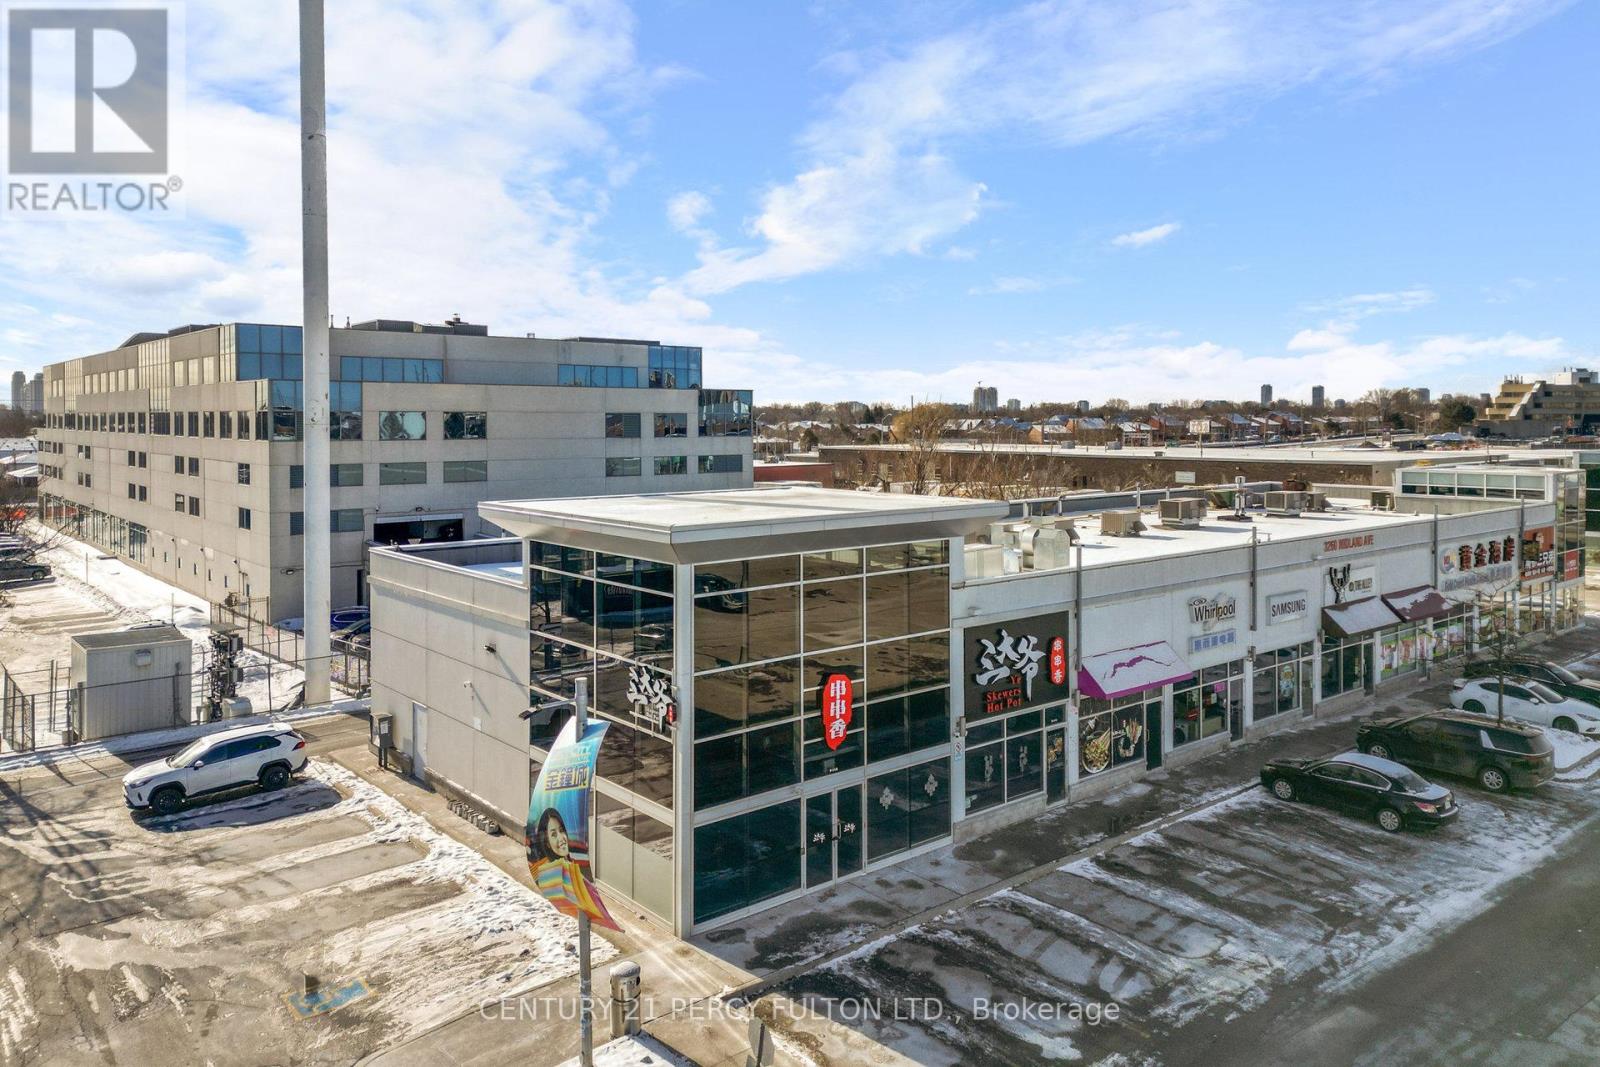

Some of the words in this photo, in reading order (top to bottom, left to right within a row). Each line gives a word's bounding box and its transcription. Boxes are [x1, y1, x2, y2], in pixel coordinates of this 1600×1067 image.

[1364, 534, 1375, 546] AVE
[1194, 599, 1236, 622] Whirlpool
[1271, 598, 1306, 617] SAMSUNG
[986, 688, 1022, 701] Skewers
[829, 680, 847, 739] 串串香
[987, 702, 1004, 713] Hot
[1007, 699, 1022, 709] Pot
